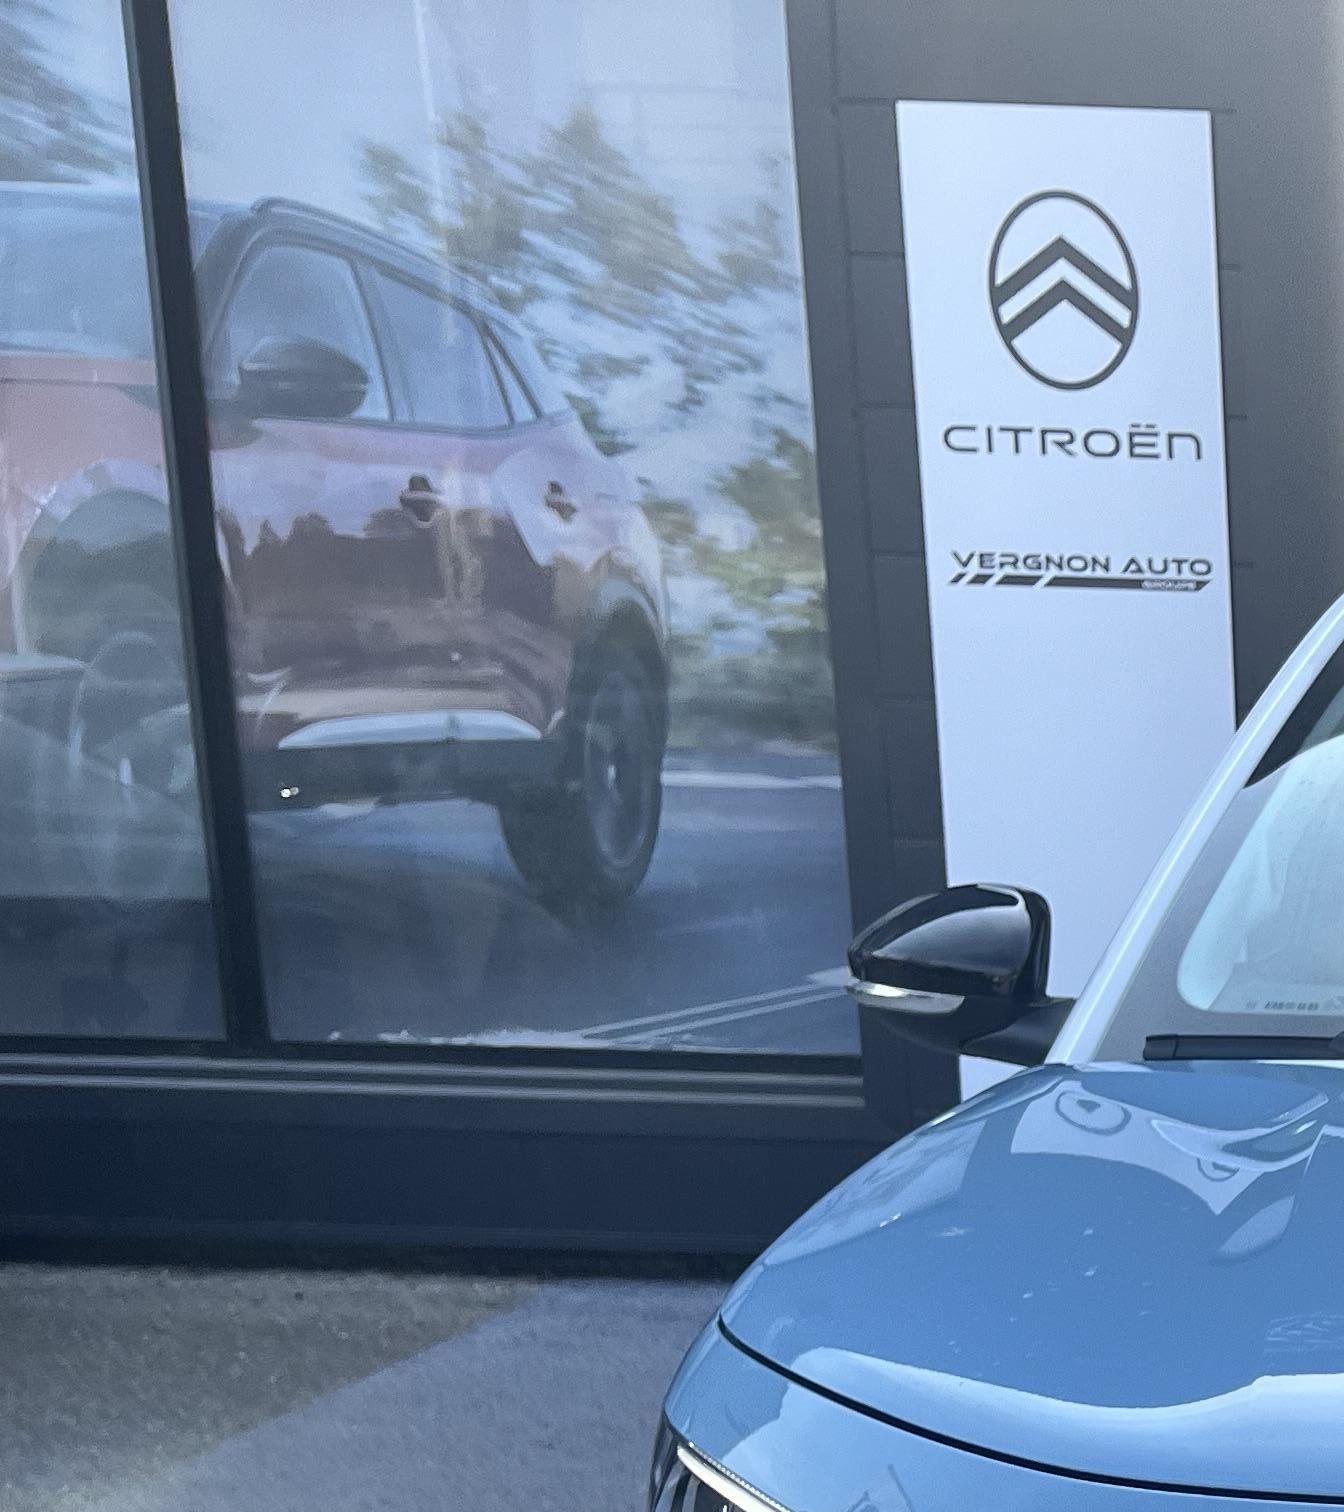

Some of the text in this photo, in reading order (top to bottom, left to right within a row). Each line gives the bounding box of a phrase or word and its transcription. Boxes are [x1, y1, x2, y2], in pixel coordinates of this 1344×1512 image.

[943, 422, 1203, 461] CITROËN
[950, 551, 1213, 577] VERGNON AUTO
